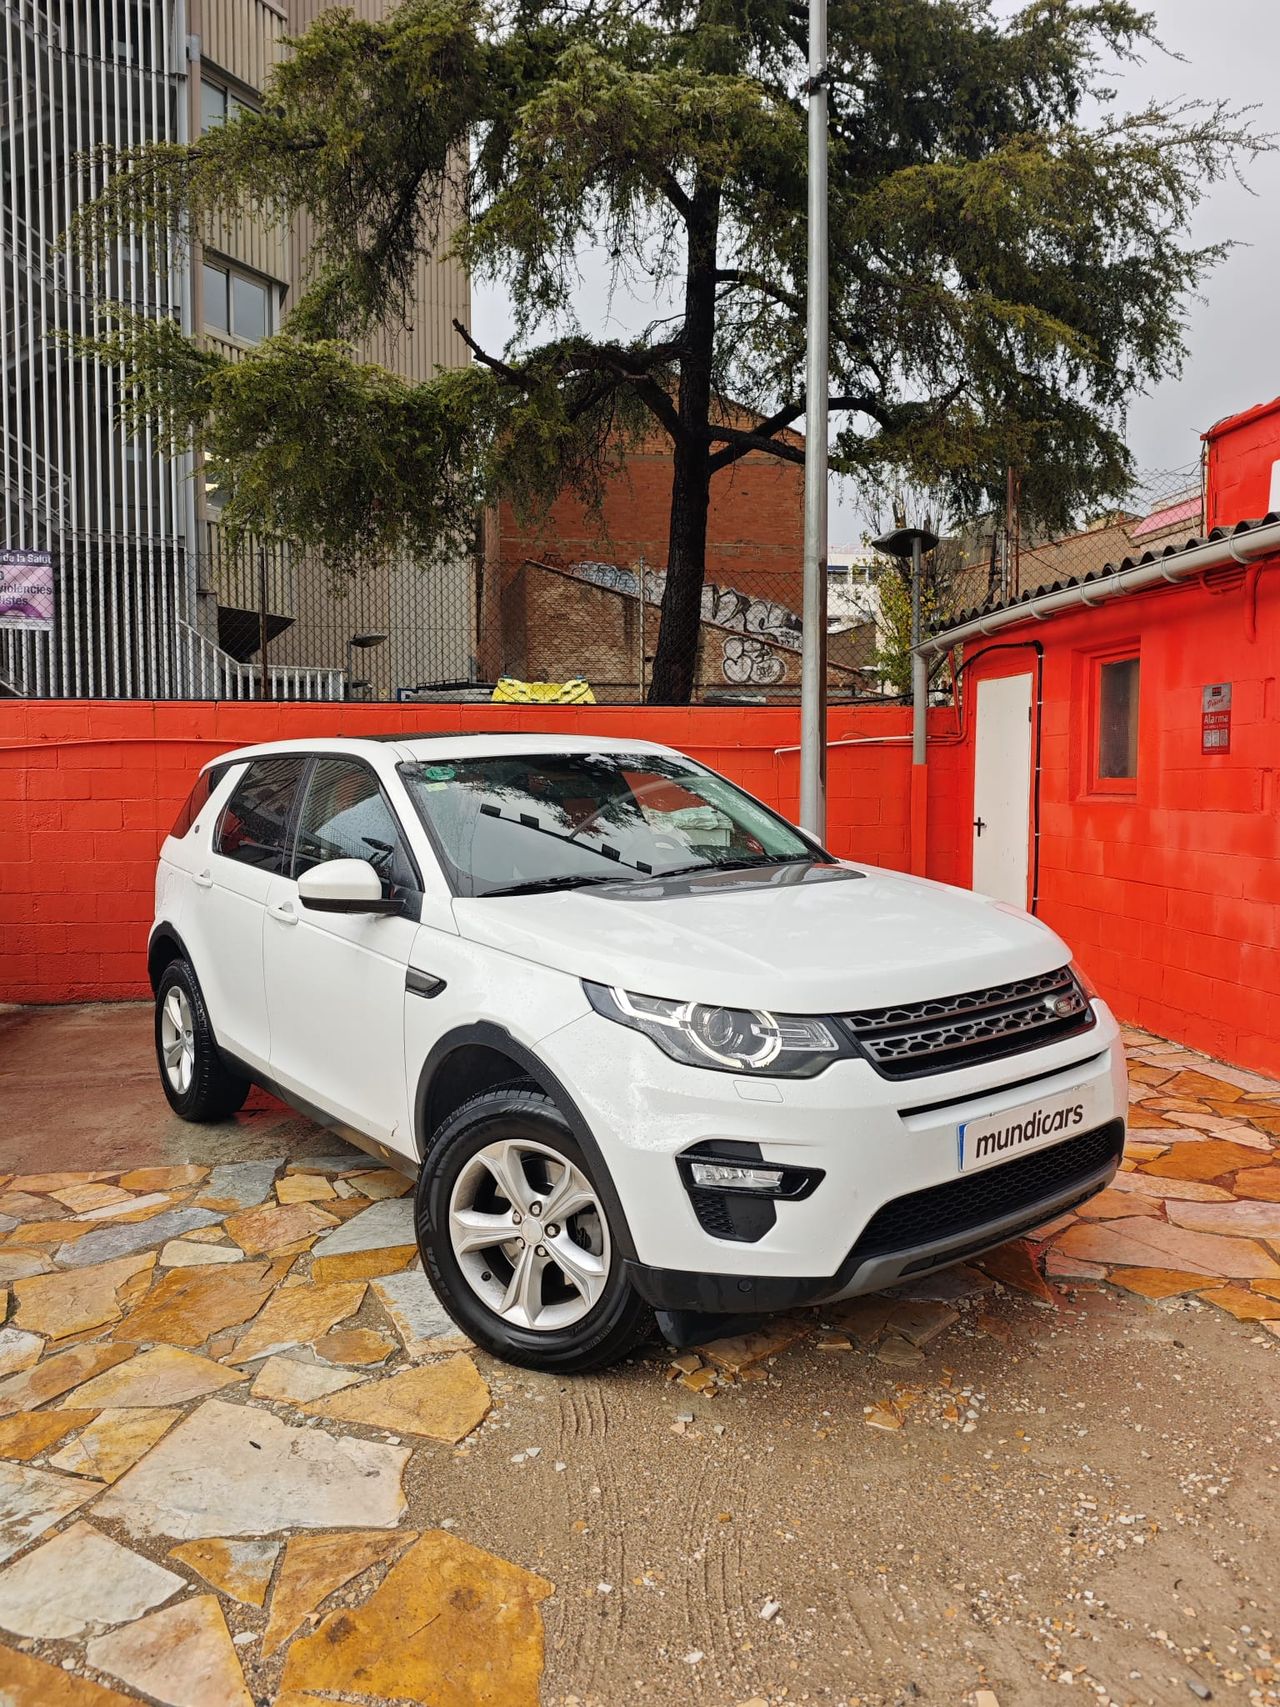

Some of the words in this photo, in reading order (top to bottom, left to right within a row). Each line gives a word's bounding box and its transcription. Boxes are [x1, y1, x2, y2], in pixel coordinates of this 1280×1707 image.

[17, 554, 26, 562] la
[28, 554, 51, 564] Salut
[1204, 714, 1228, 724] Alarma
[976, 1104, 1083, 1158] mundicars
